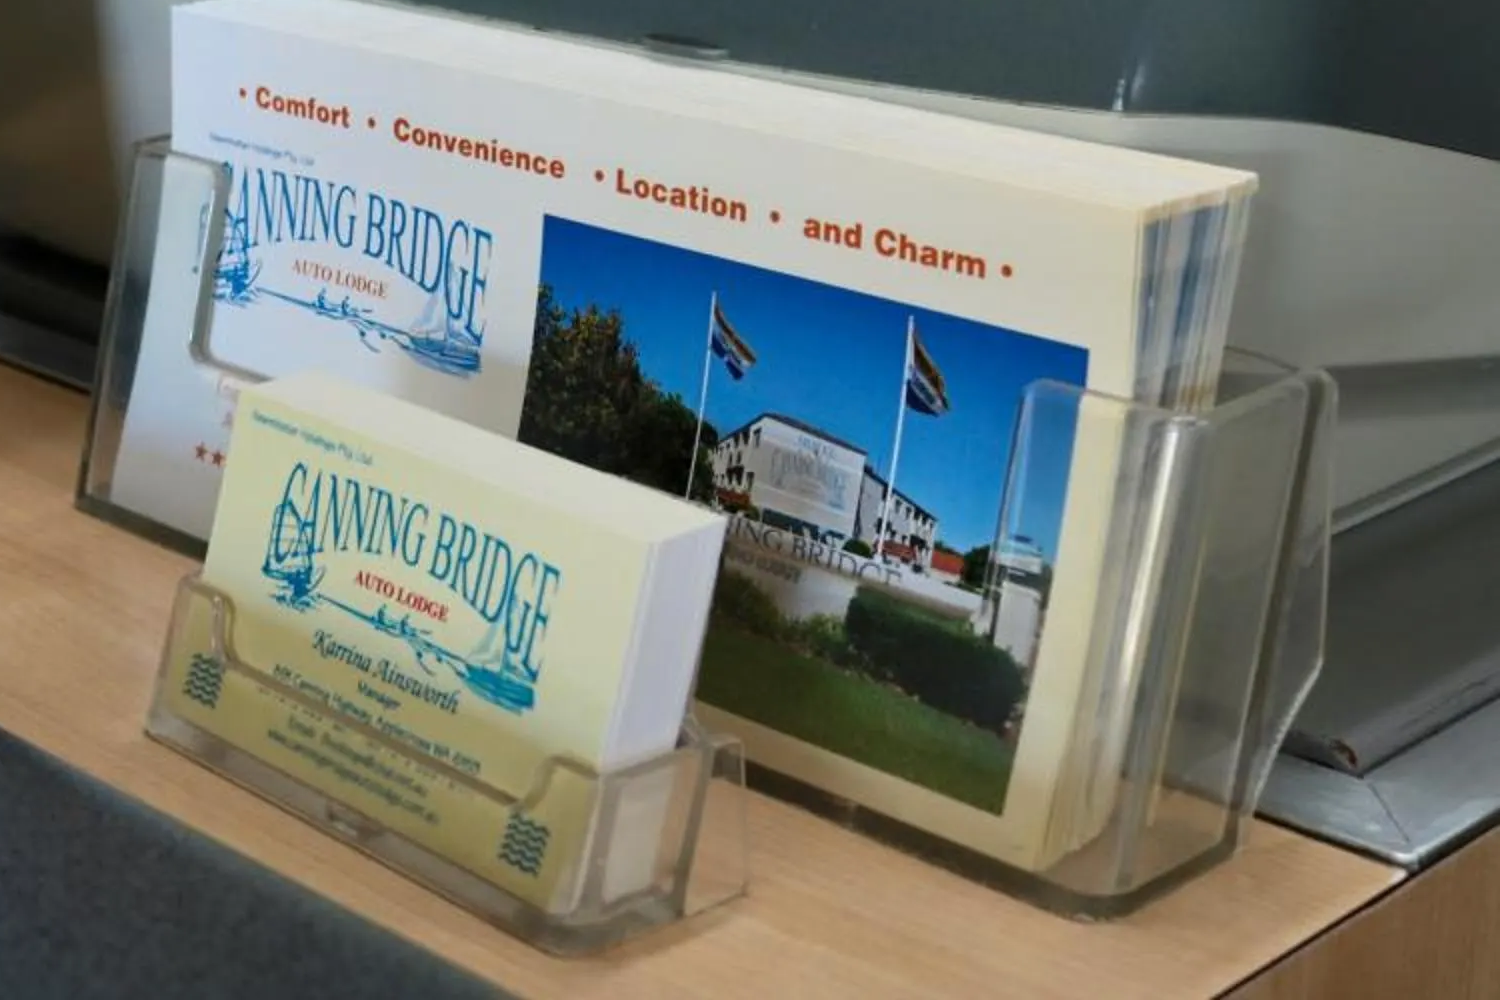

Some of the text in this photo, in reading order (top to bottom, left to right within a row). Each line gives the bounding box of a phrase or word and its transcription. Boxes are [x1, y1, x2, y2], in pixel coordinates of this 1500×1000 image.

[255, 85, 986, 279] Comfort Convenience Location and Charm
[292, 258, 389, 300] AUTO LODGE
[363, 192, 494, 345] BRIDGE
[273, 461, 562, 684] CANNING BRIDGE
[355, 570, 450, 623] AUTO LODGE
[311, 628, 461, 716] Karrina Ainsworth
